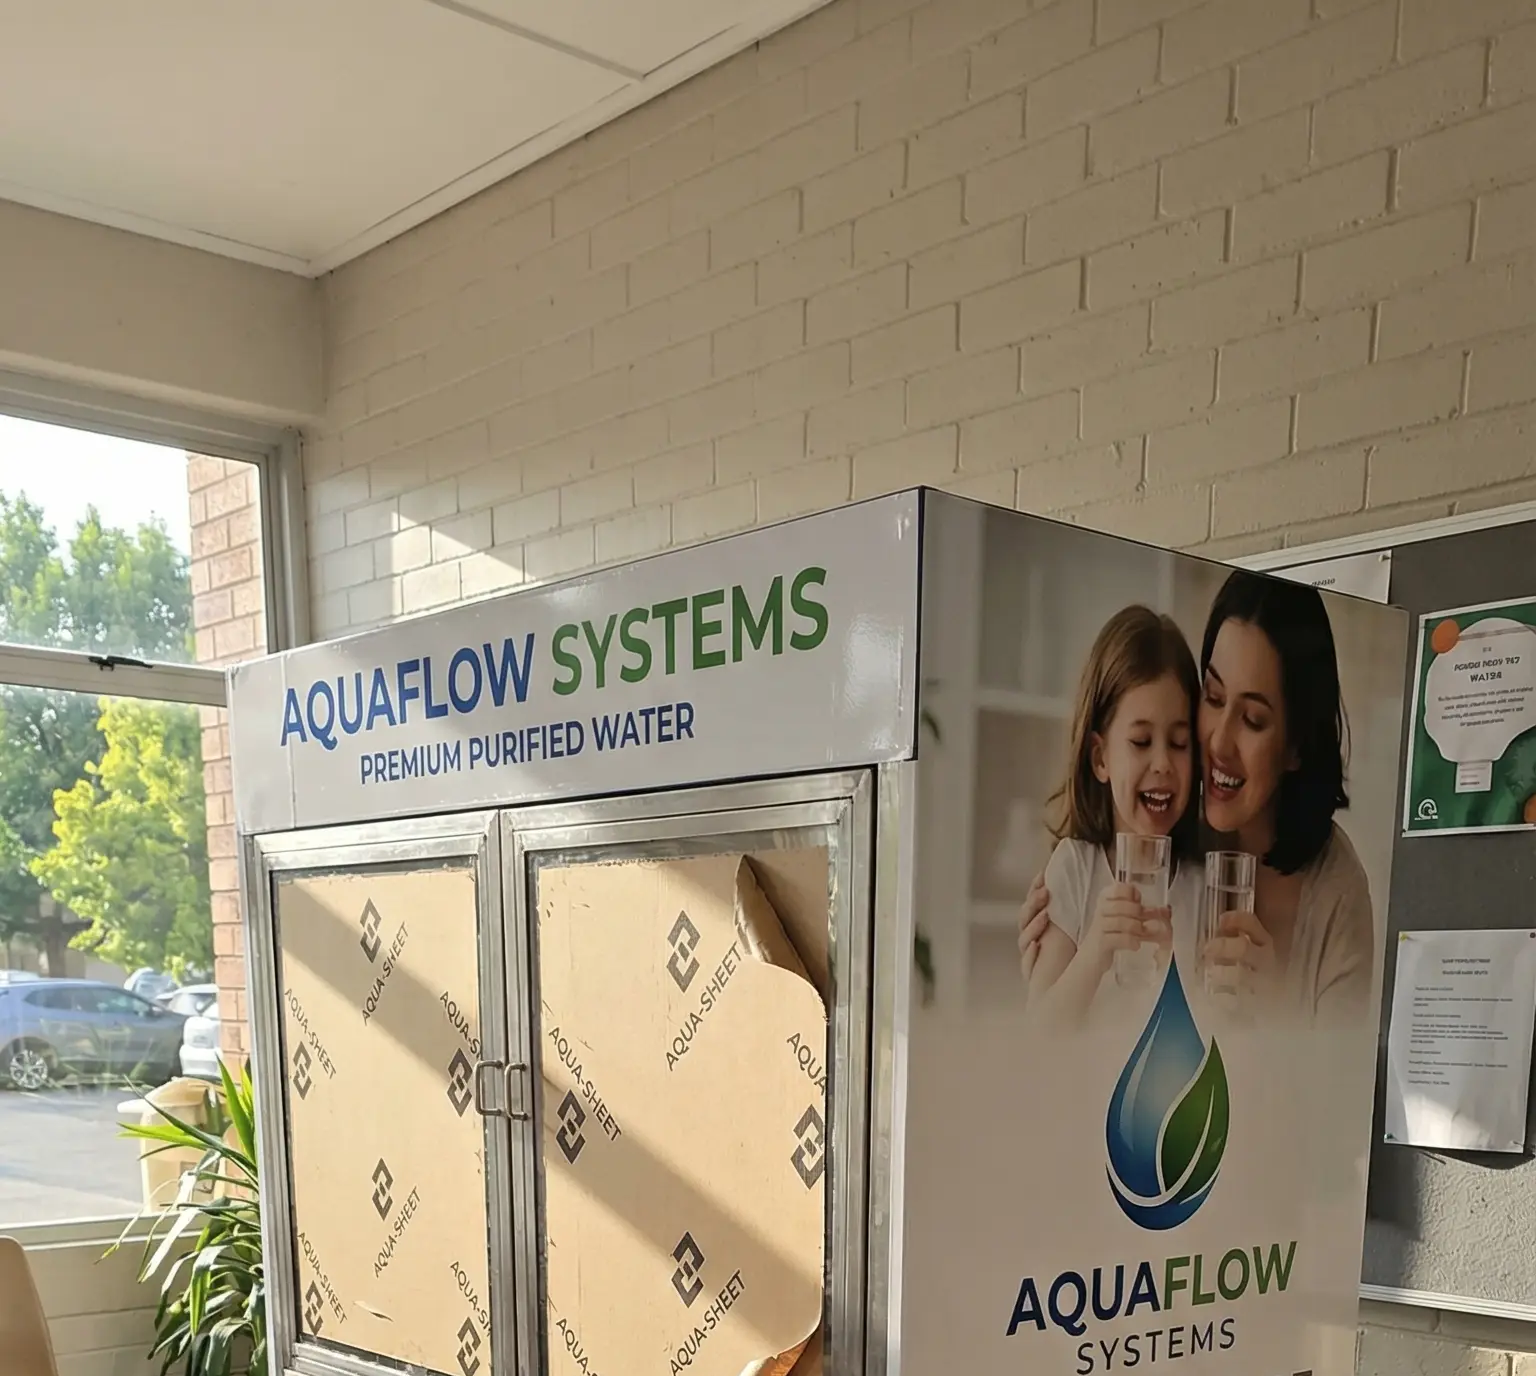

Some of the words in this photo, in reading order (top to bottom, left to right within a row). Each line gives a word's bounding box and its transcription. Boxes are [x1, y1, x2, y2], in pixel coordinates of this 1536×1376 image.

[280, 633, 535, 751] AQUAFLOW
[551, 567, 829, 696] SYSTEMS
[361, 740, 462, 785] PREMIUM
[469, 720, 585, 771] PURIFIED
[592, 702, 695, 752] WATER
[362, 921, 409, 1026] AQUA-SHEET
[665, 941, 743, 1071] AQUA-SHEET
[284, 988, 337, 1080] AQUA-SHEET
[548, 1026, 622, 1142] AQUA-SHEET
[373, 1186, 421, 1279] AQUA-SHEET
[1005, 1240, 1298, 1337] AQUAFLOW
[1076, 1318, 1237, 1376] SYSTEMS
